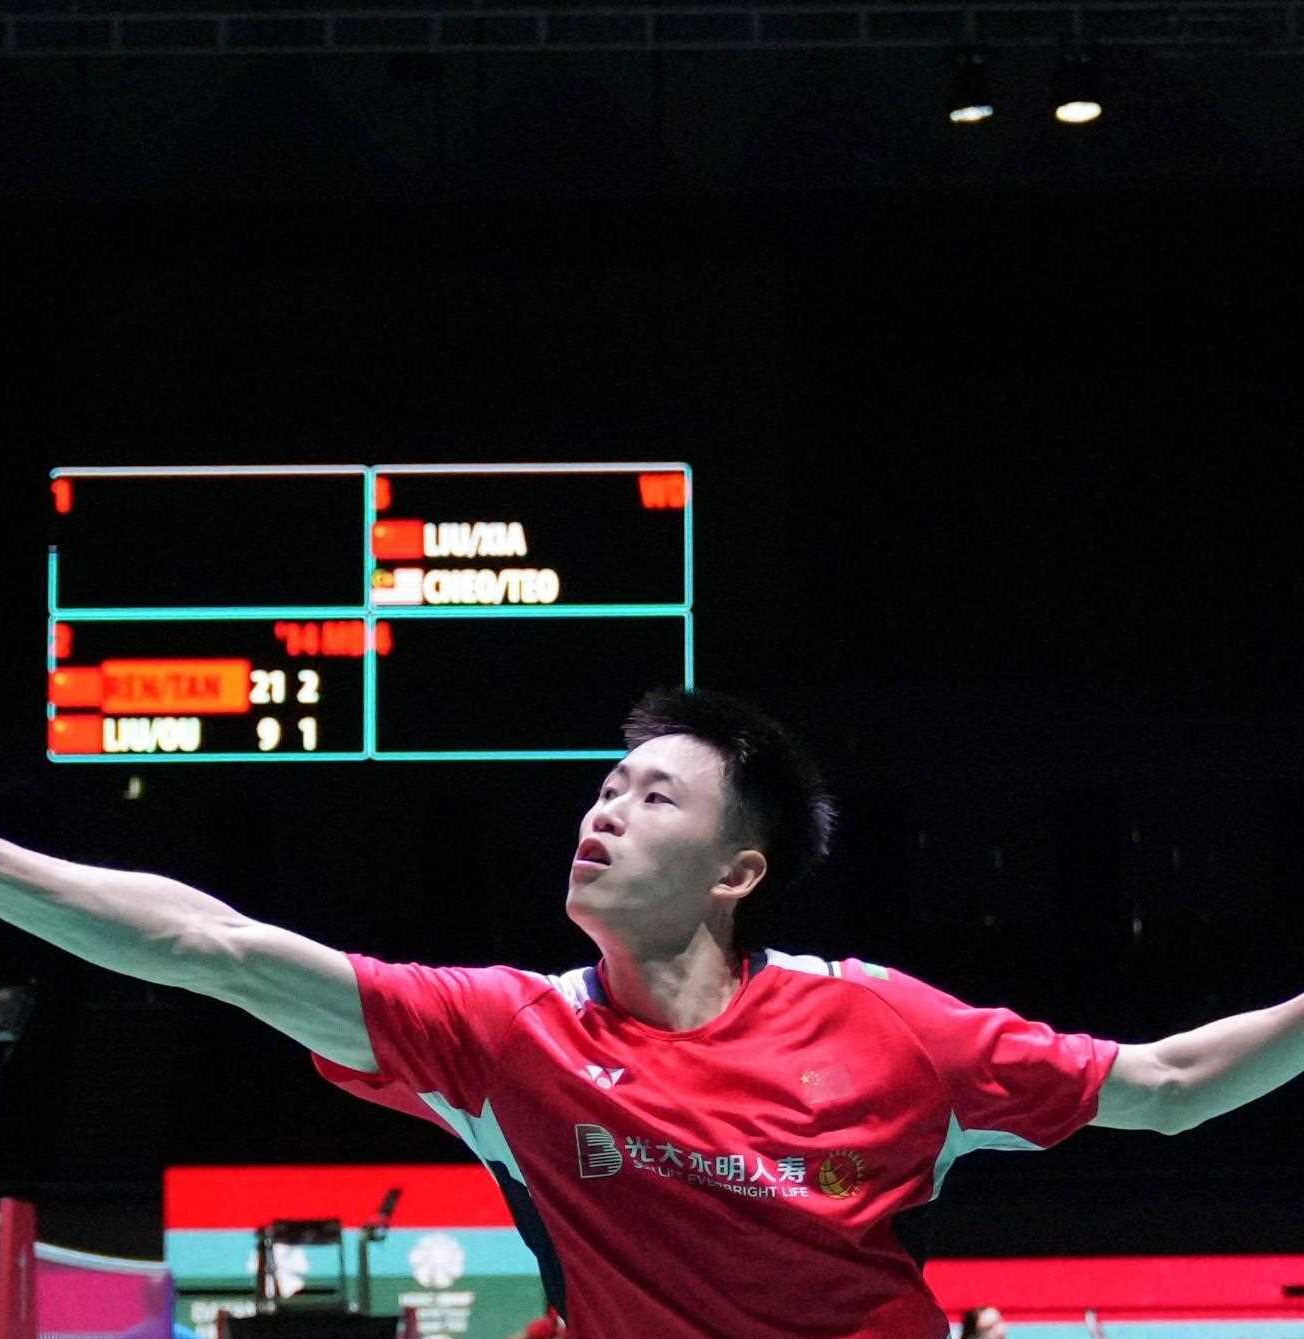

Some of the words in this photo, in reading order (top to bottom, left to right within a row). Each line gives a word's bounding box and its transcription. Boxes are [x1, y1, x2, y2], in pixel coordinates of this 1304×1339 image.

[250, 669, 285, 704] 21
[297, 669, 319, 704] 2
[257, 717, 280, 752] 9
[297, 717, 317, 752] 1
[782, 1187, 808, 1198] LIFE
